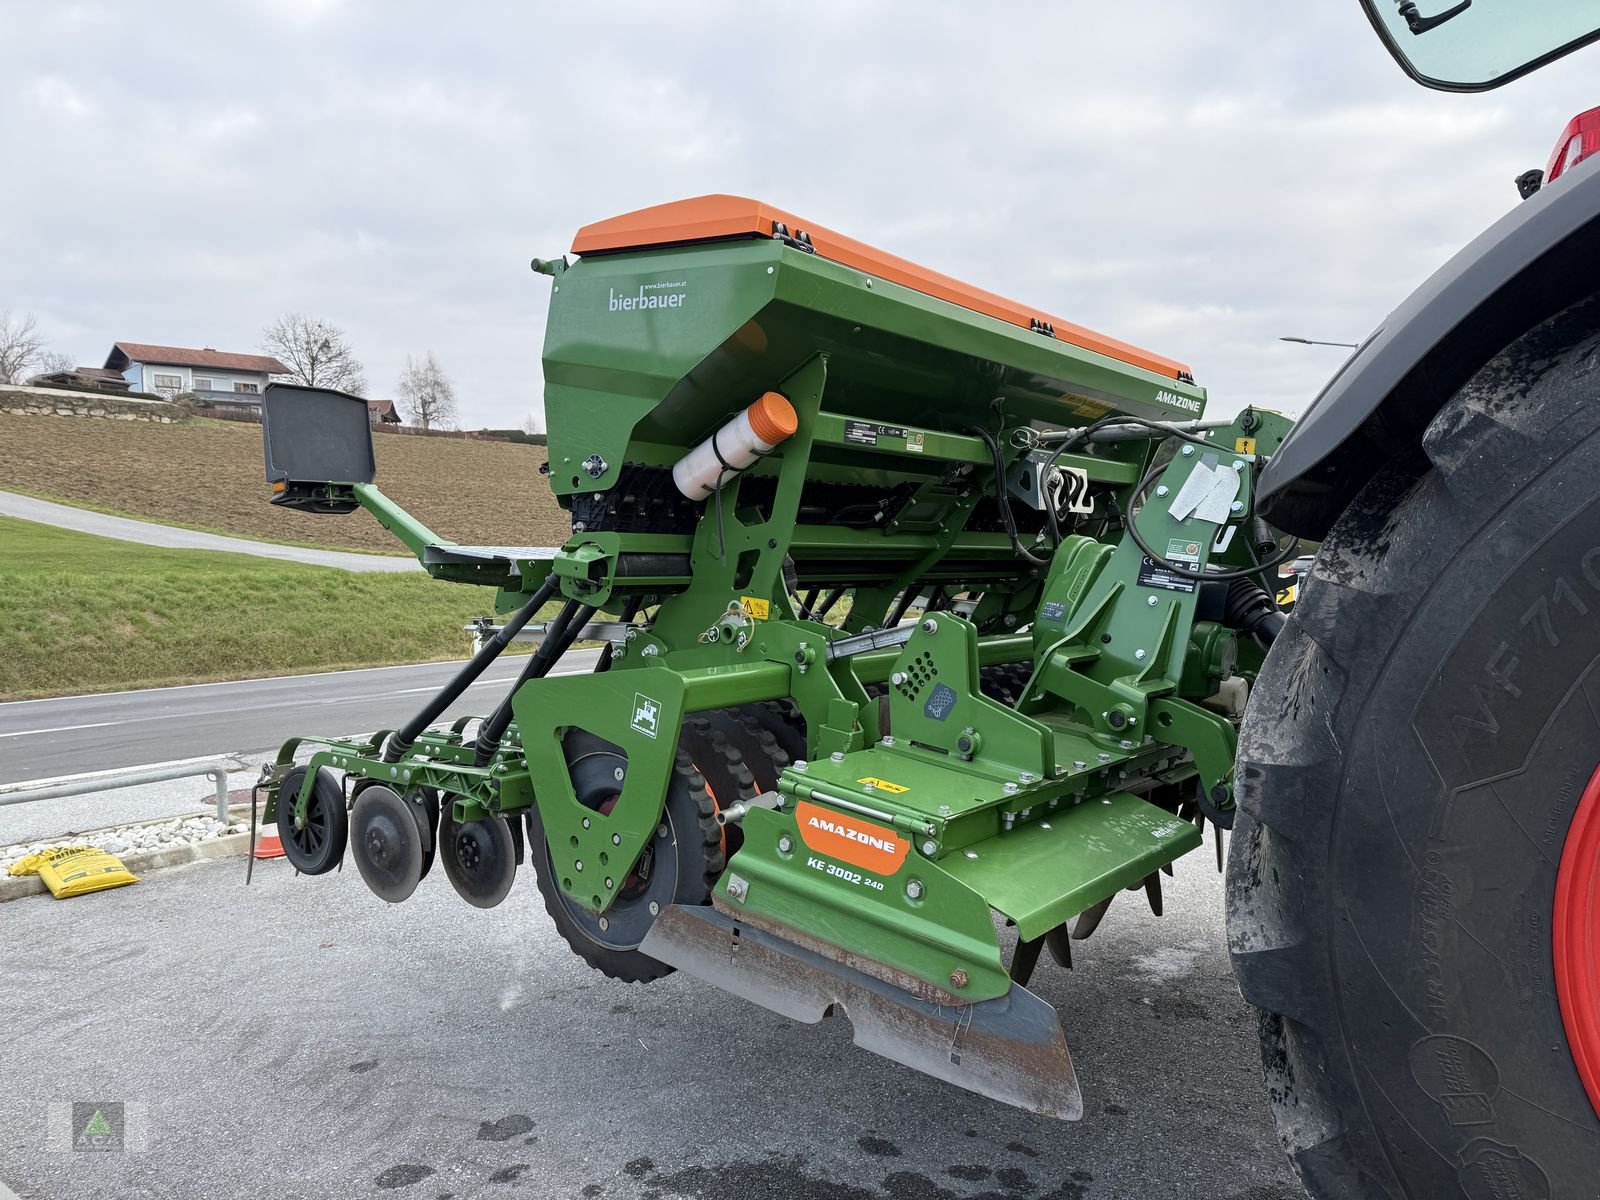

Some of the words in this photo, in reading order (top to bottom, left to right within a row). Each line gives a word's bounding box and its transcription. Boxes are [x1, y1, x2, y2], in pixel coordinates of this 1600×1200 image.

[609, 286, 686, 311] bierbauer
[644, 281, 687, 290] www.bierbauer.at
[1155, 391, 1201, 412] AMAZONE
[1453, 641, 1522, 733] VF
[808, 816, 896, 854] AMAZONE
[807, 857, 826, 871] KE
[826, 864, 862, 885] 3002
[864, 878, 884, 891] 240
